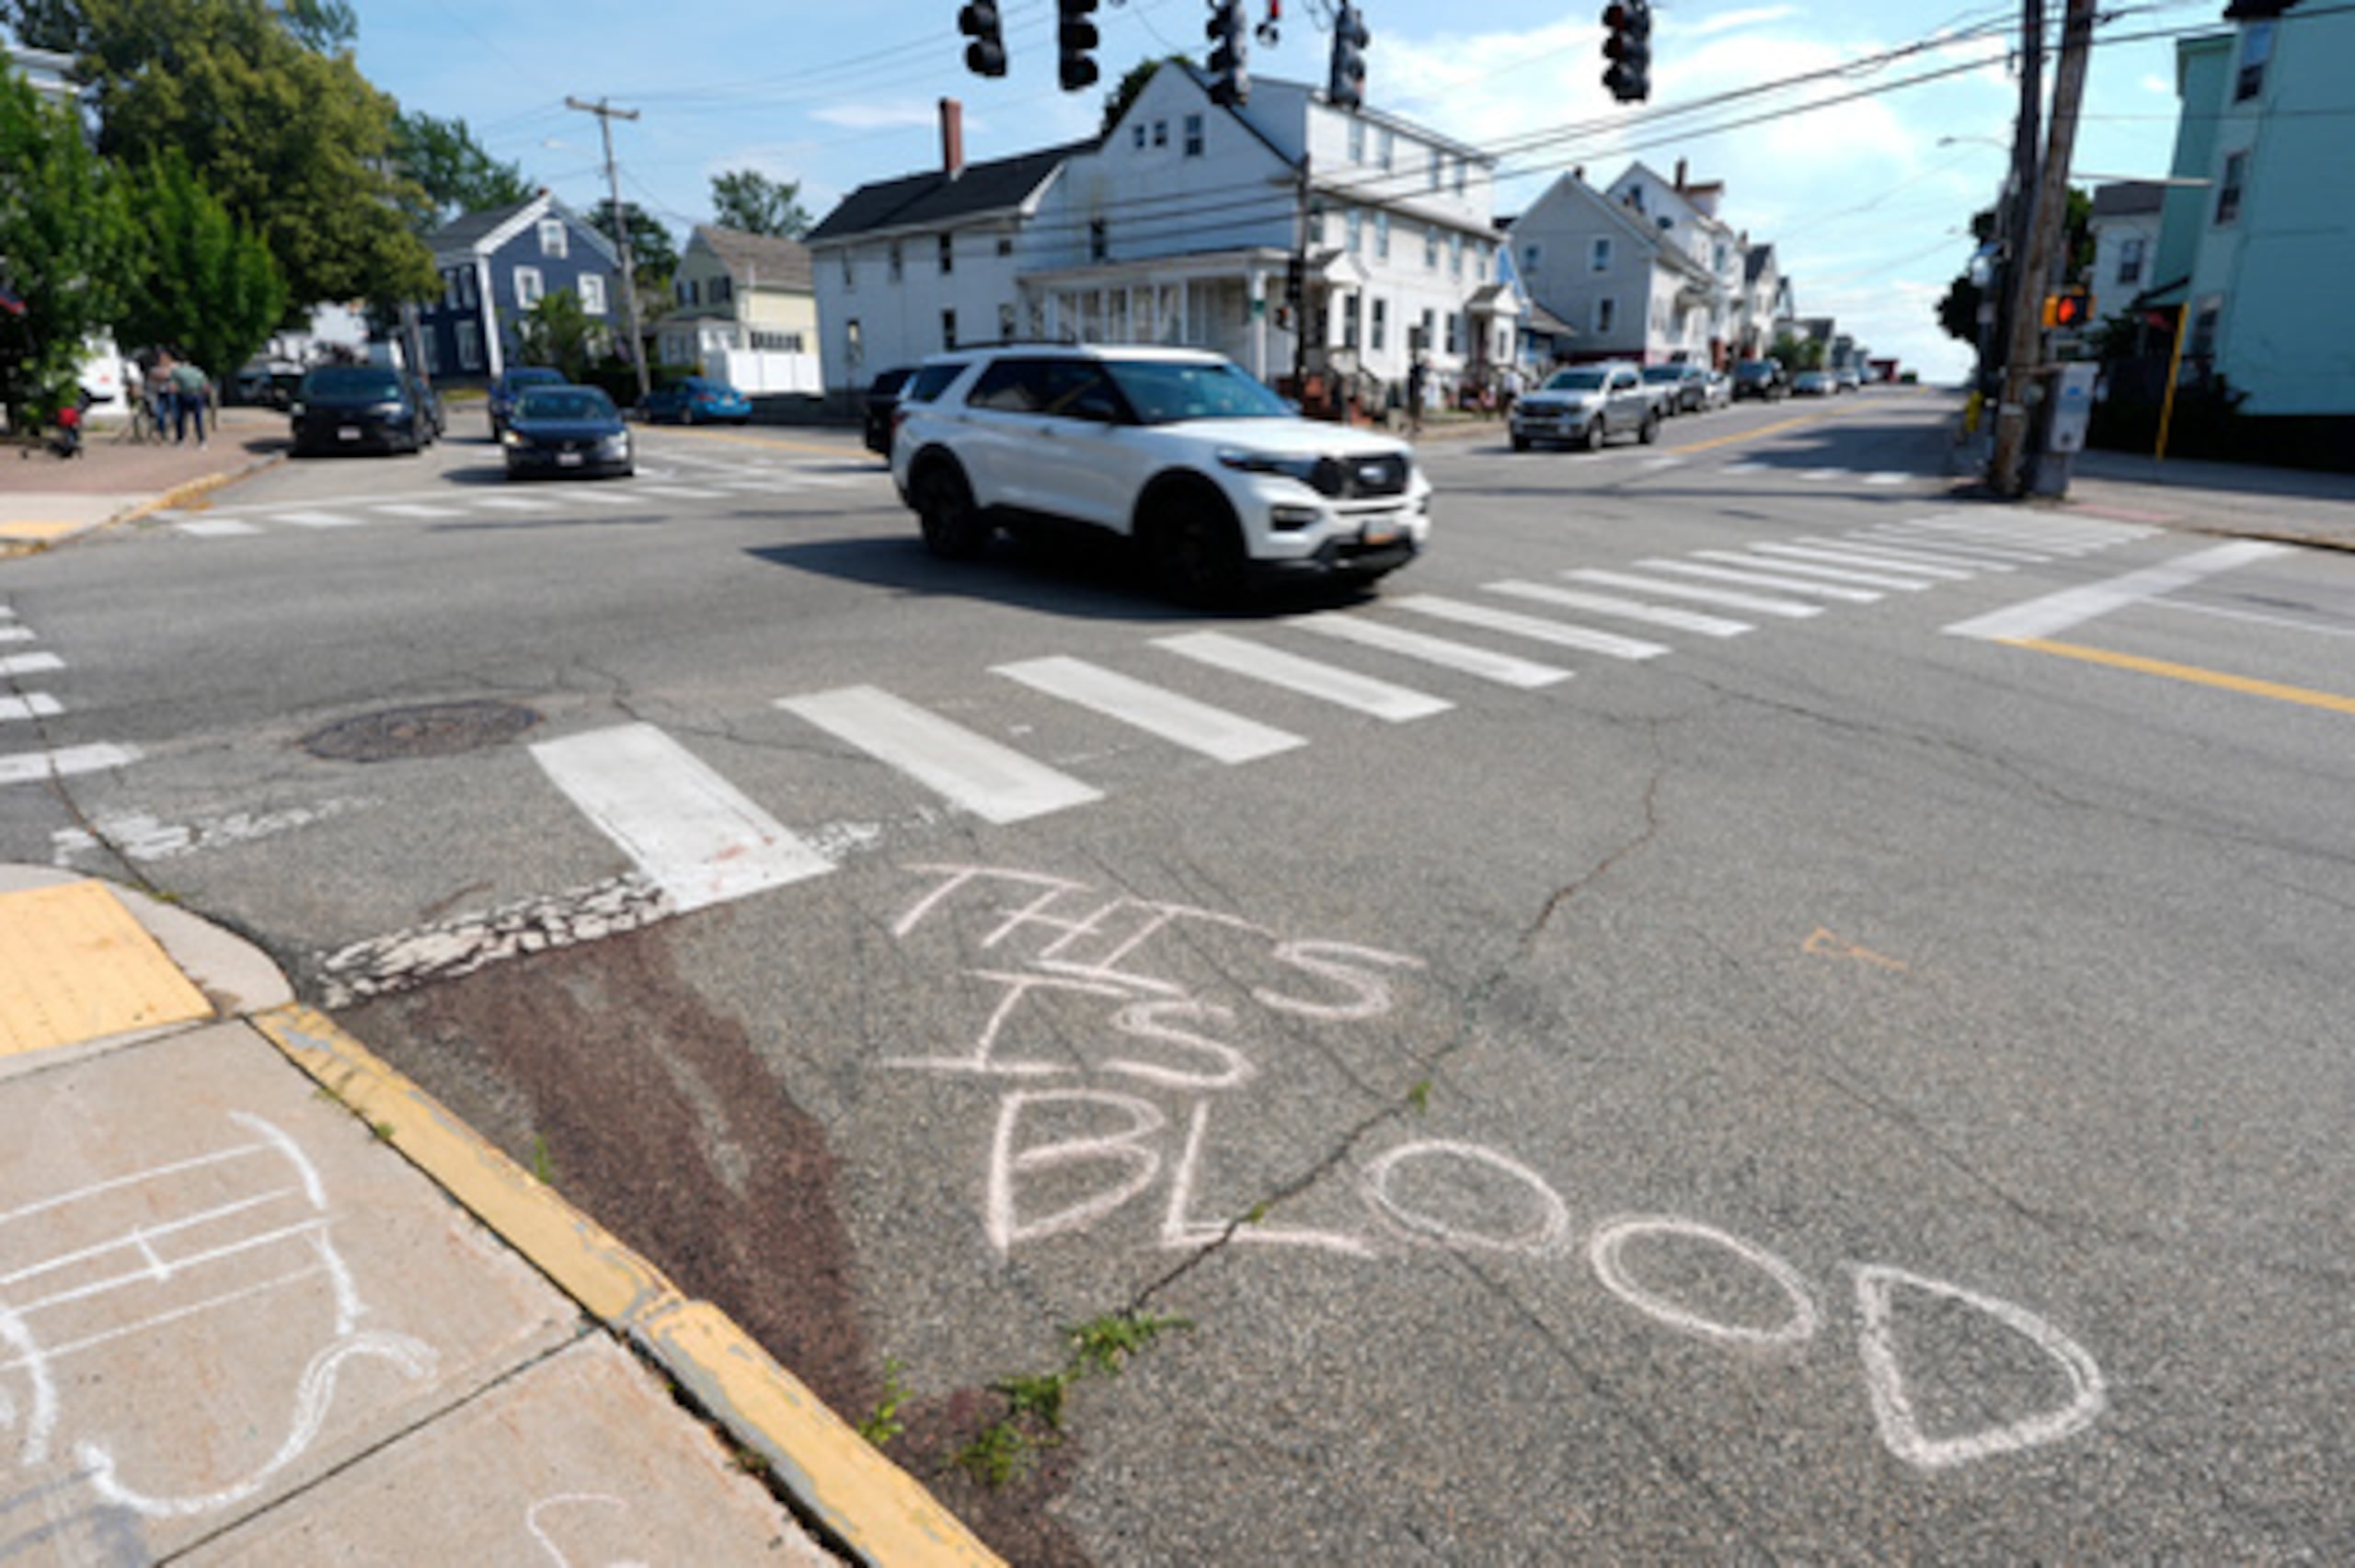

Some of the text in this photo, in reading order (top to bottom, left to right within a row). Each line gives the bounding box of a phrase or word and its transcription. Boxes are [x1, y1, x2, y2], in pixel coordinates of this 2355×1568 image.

[893, 862, 1427, 1017] THIS
[880, 968, 1257, 1089] IS
[984, 1089, 2107, 1467] BLOOD
